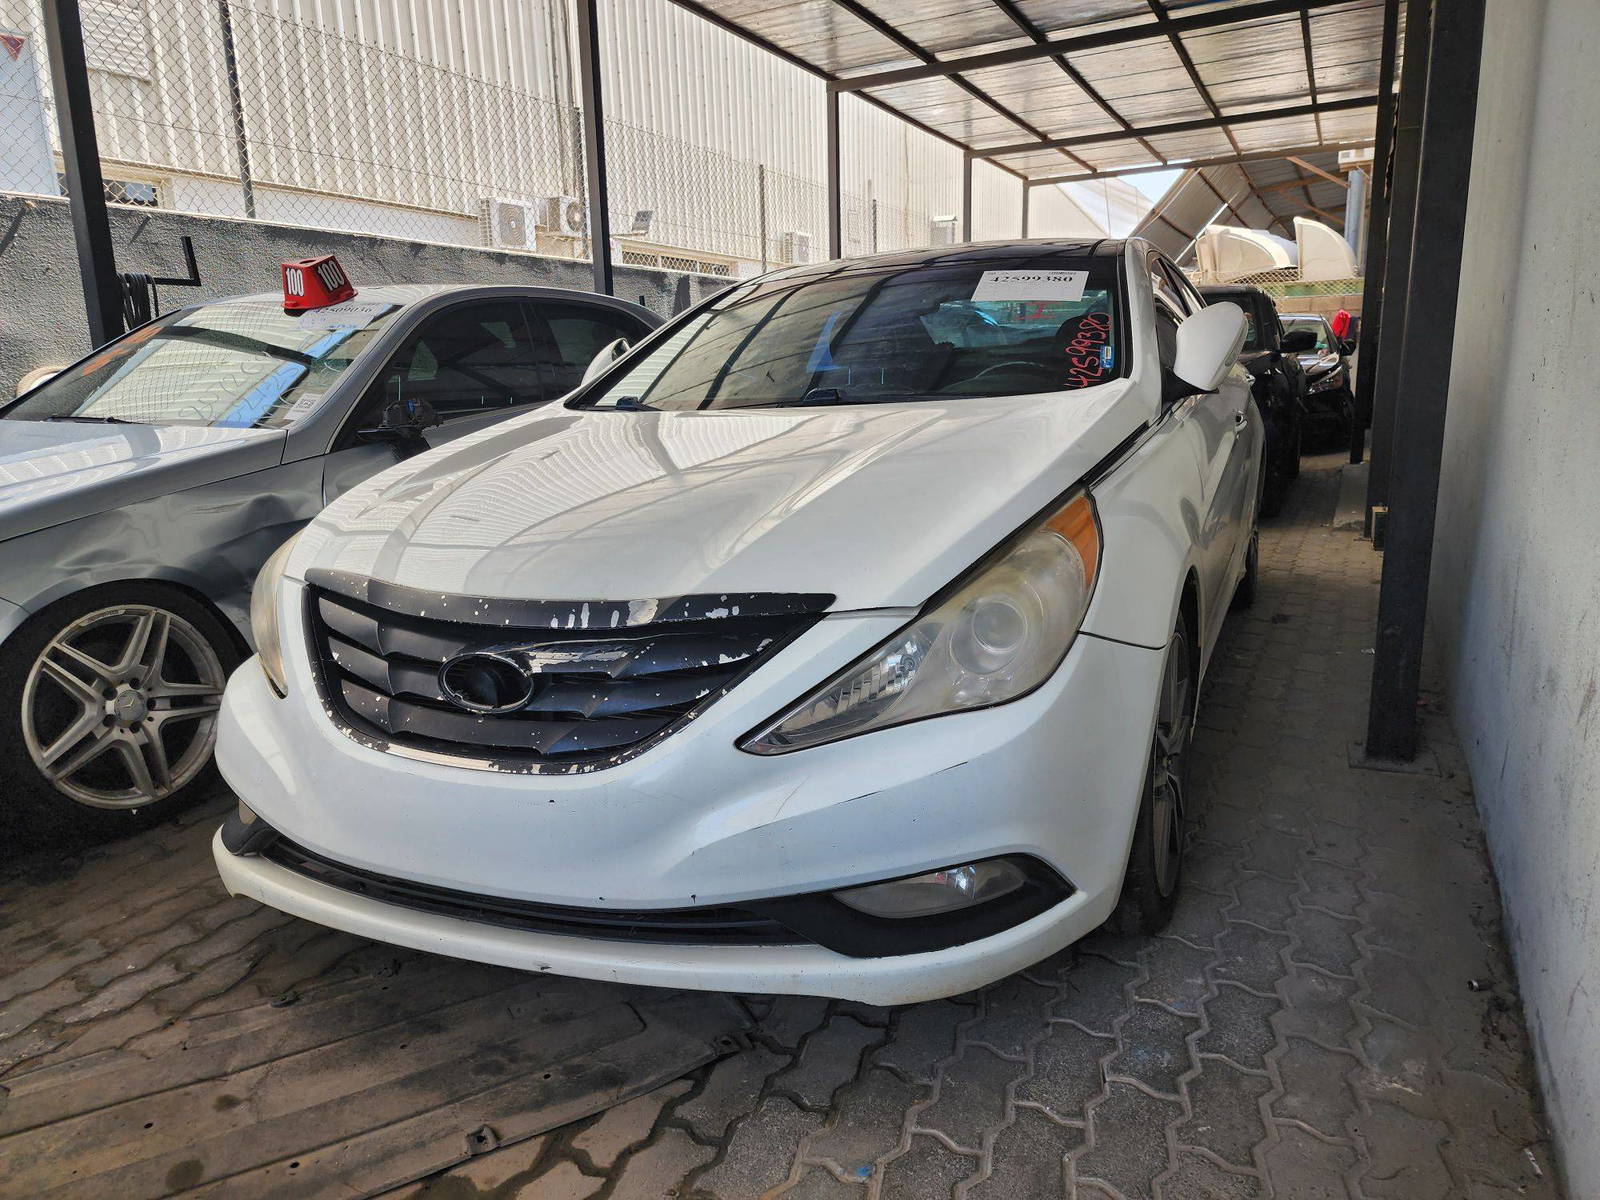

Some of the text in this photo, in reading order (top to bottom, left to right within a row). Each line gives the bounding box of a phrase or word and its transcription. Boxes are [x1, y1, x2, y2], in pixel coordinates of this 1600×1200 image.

[286, 268, 304, 296] 100
[318, 260, 345, 291] 100
[1063, 312, 1111, 388] 42599380
